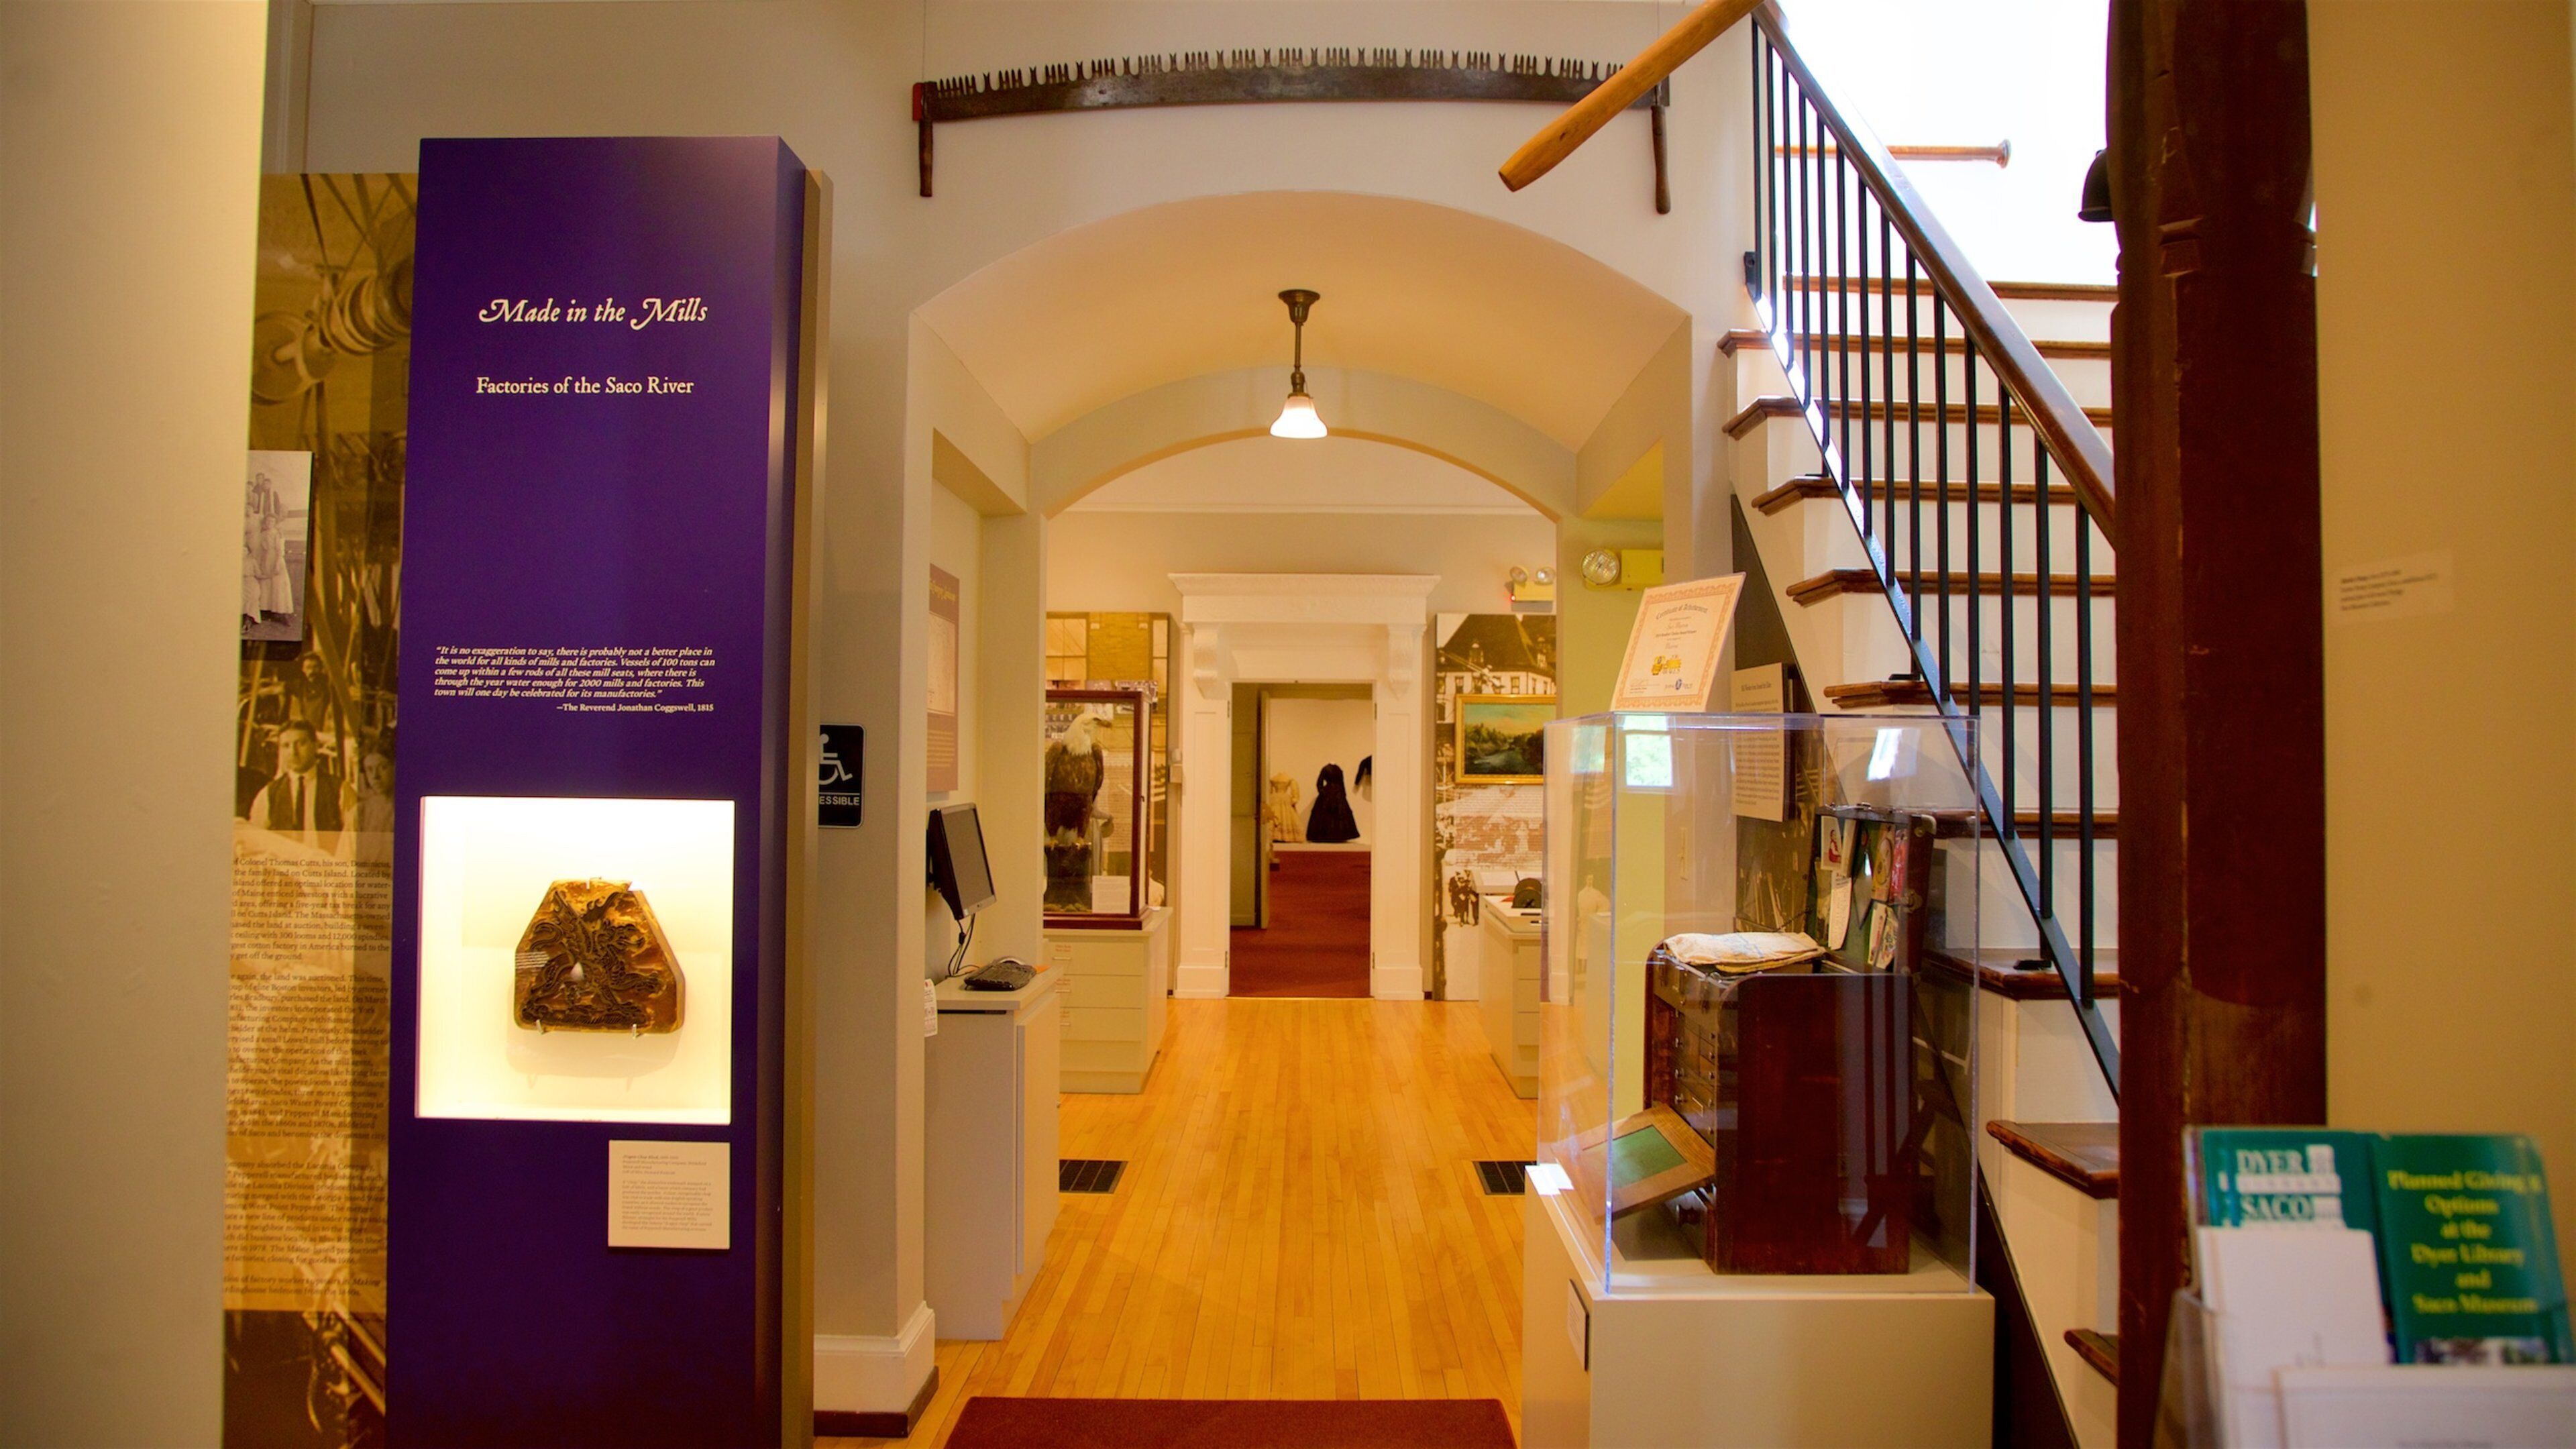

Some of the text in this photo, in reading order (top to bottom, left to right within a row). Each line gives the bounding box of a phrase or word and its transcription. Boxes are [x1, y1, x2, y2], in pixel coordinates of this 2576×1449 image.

[479, 297, 708, 331] Made in the Mills
[476, 376, 694, 396] Factories of the Saco River
[436, 647, 448, 655] “It
[472, 647, 526, 657] exaggeration
[556, 647, 580, 655] there
[588, 647, 626, 657] probably
[652, 647, 677, 655] better
[678, 647, 702, 657] place
[435, 657, 448, 665] the
[451, 657, 476, 665] world
[477, 657, 489, 665] for
[490, 657, 502, 665] all
[504, 657, 527, 665] kinds
[528, 657, 538, 665] of
[538, 657, 559, 665] mills
[561, 657, 577, 665] and
[579, 657, 618, 665] factories.
[621, 658, 651, 666] Vessels
[651, 658, 662, 666] of
[662, 658, 678, 666] 100
[459, 669, 470, 678] up
[472, 667, 499, 676] within
[508, 668, 524, 676] few
[525, 668, 544, 676] rods
[545, 668, 555, 676] of
[555, 668, 568, 676] all
[569, 668, 591, 676] these
[592, 668, 609, 676] mill
[611, 669, 635, 678] seats,
[638, 668, 663, 676] where
[665, 669, 687, 677] there
[435, 678, 468, 688] through
[470, 678, 484, 686] the
[484, 680, 504, 688] year
[532, 678, 563, 688] enough
[564, 678, 576, 686] for
[579, 678, 602, 686] 2000
[603, 679, 625, 687] mills
[626, 679, 643, 687] and
[644, 679, 683, 687] factories.
[686, 679, 705, 687] This
[458, 688, 474, 696] will
[492, 688, 508, 698] day
[509, 688, 519, 696] be
[521, 688, 565, 696] celebrated
[566, 689, 579, 697] for
[594, 689, 663, 697] manufactories.”
[557, 703, 714, 714] —The Reverend Jonathan Coggswell, 1815
[2236, 1149, 2304, 1174] DYER
[2387, 1170, 2463, 1190] Planned
[2241, 1195, 2312, 1221] SACO
[2424, 1195, 2500, 1218] Options
